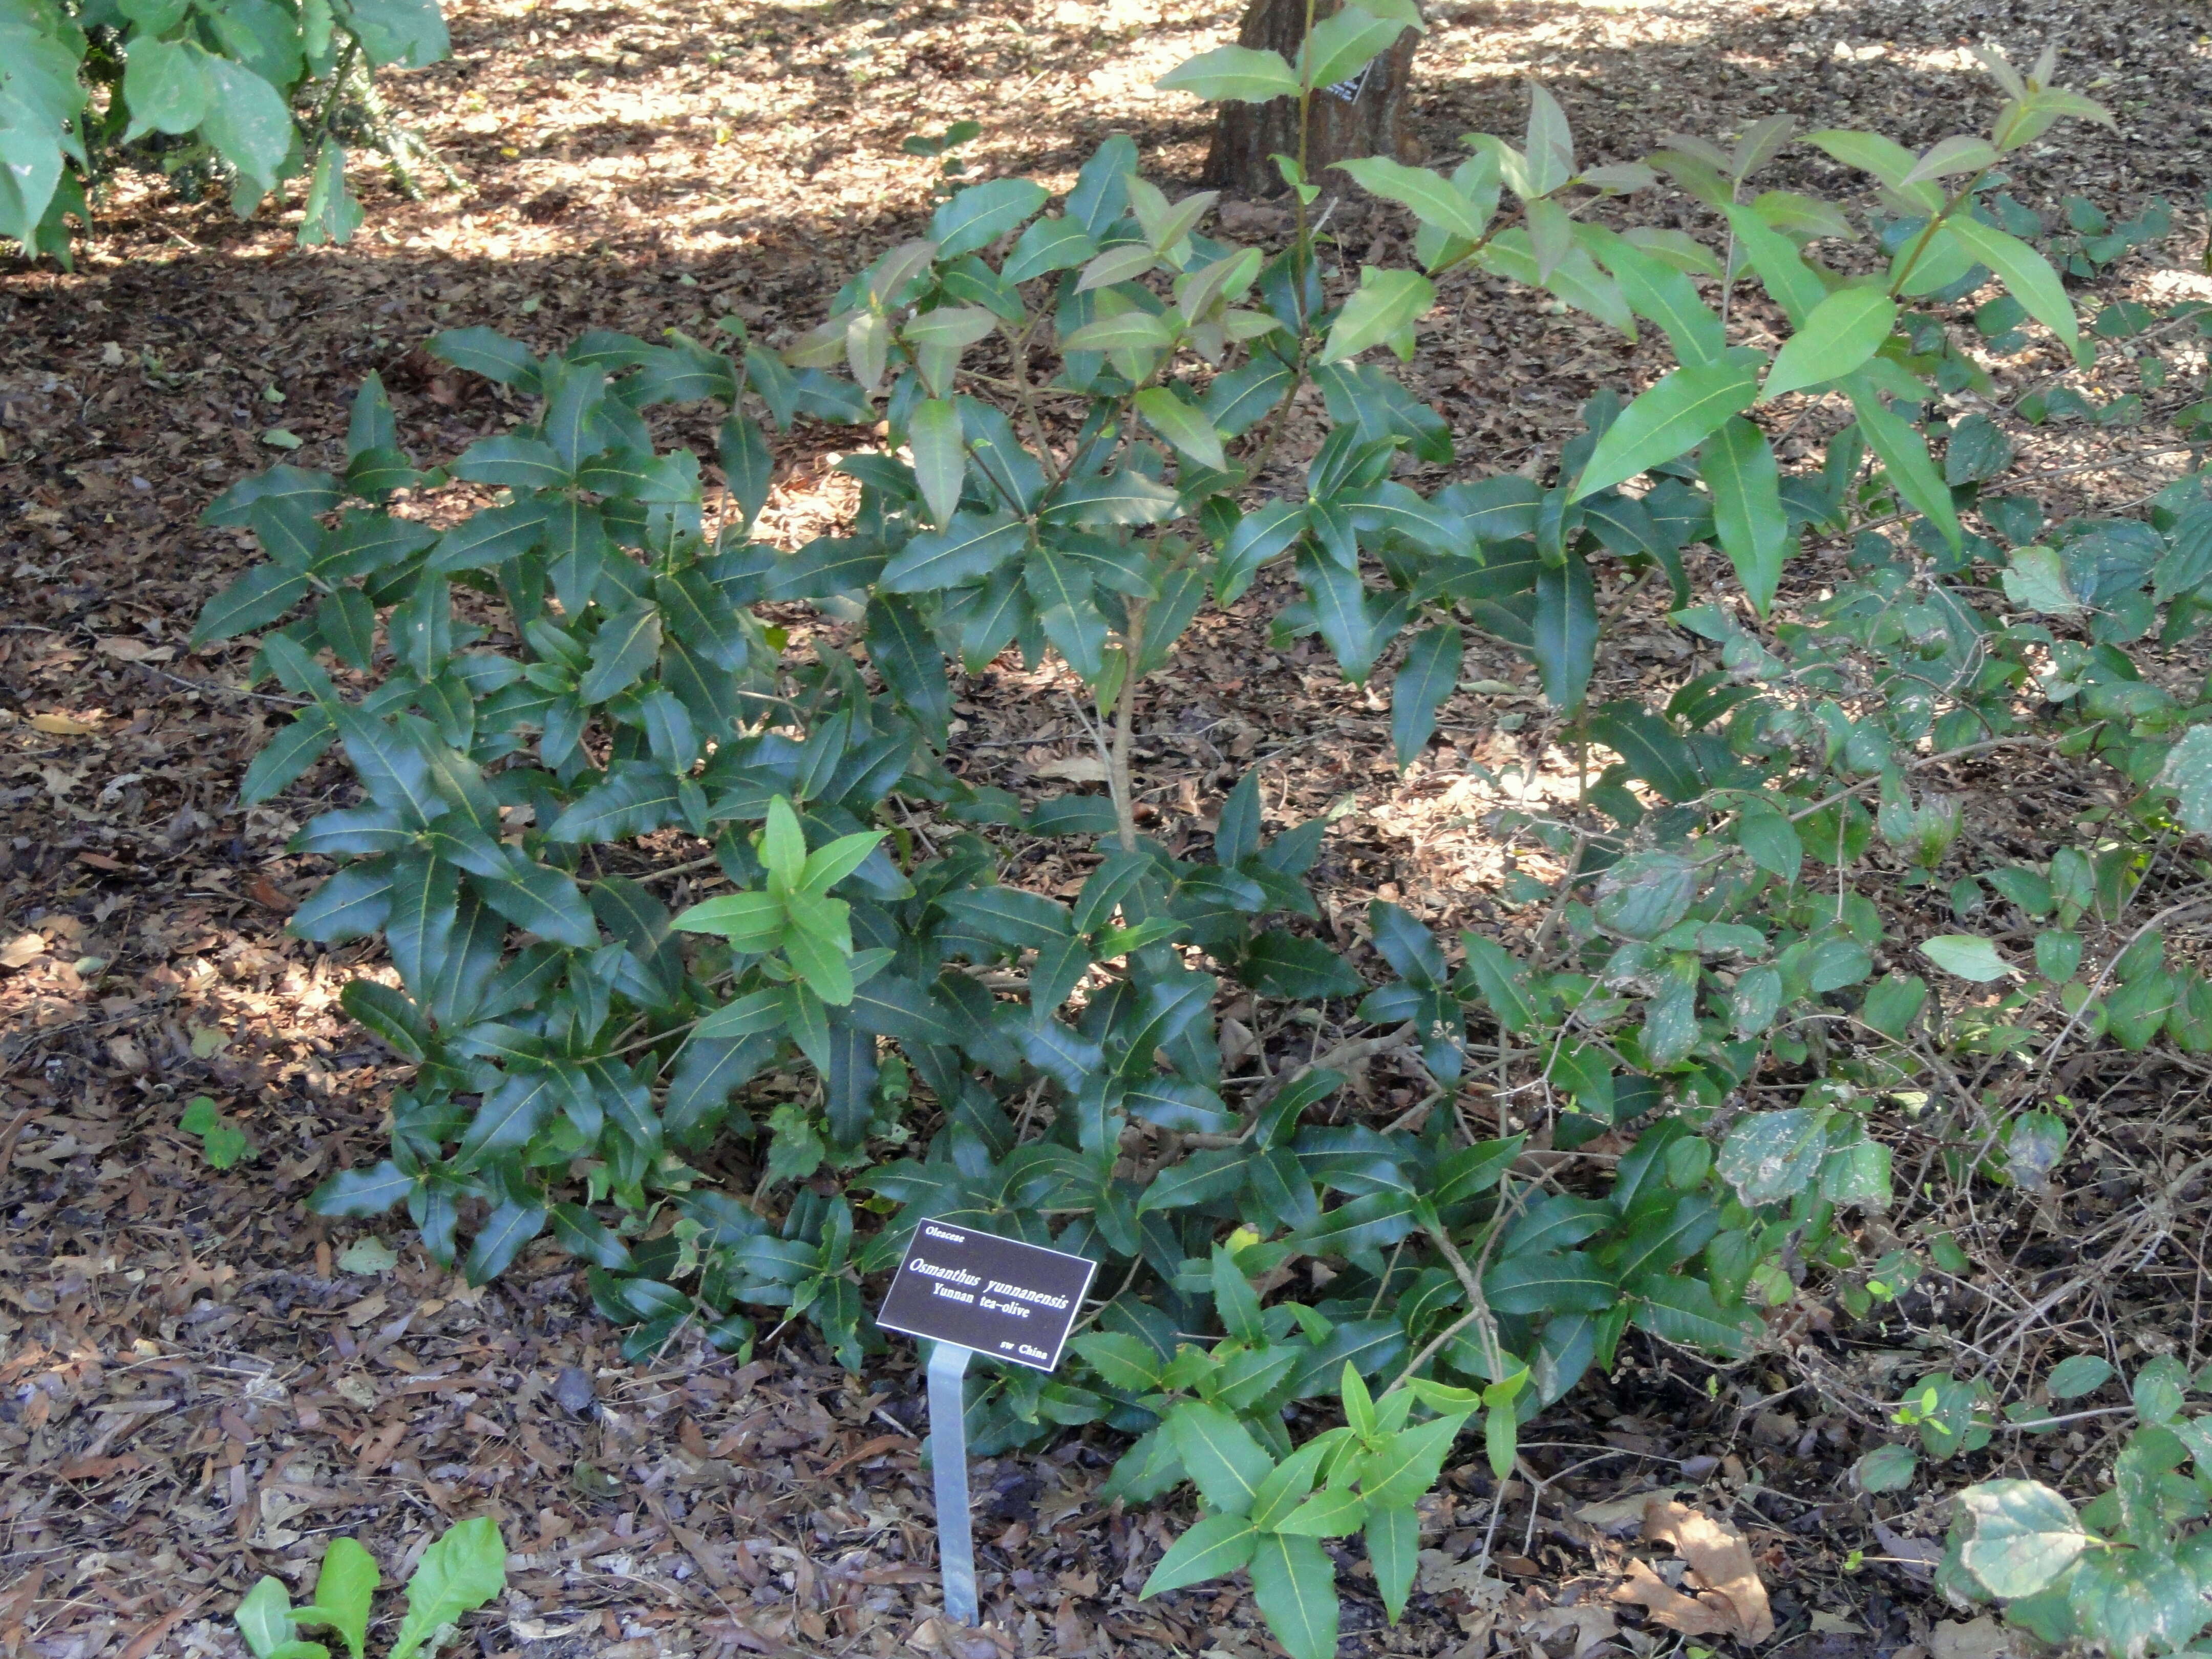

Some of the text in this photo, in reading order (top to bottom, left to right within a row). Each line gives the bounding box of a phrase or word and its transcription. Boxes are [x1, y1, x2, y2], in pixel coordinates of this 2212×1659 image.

[925, 1226, 965, 1243] Oleaceae
[909, 1258, 1069, 1310] Osmanthus yunnanensis
[932, 1282, 1031, 1318] Yunnan tea-olive
[999, 1339, 1048, 1360] sw China
